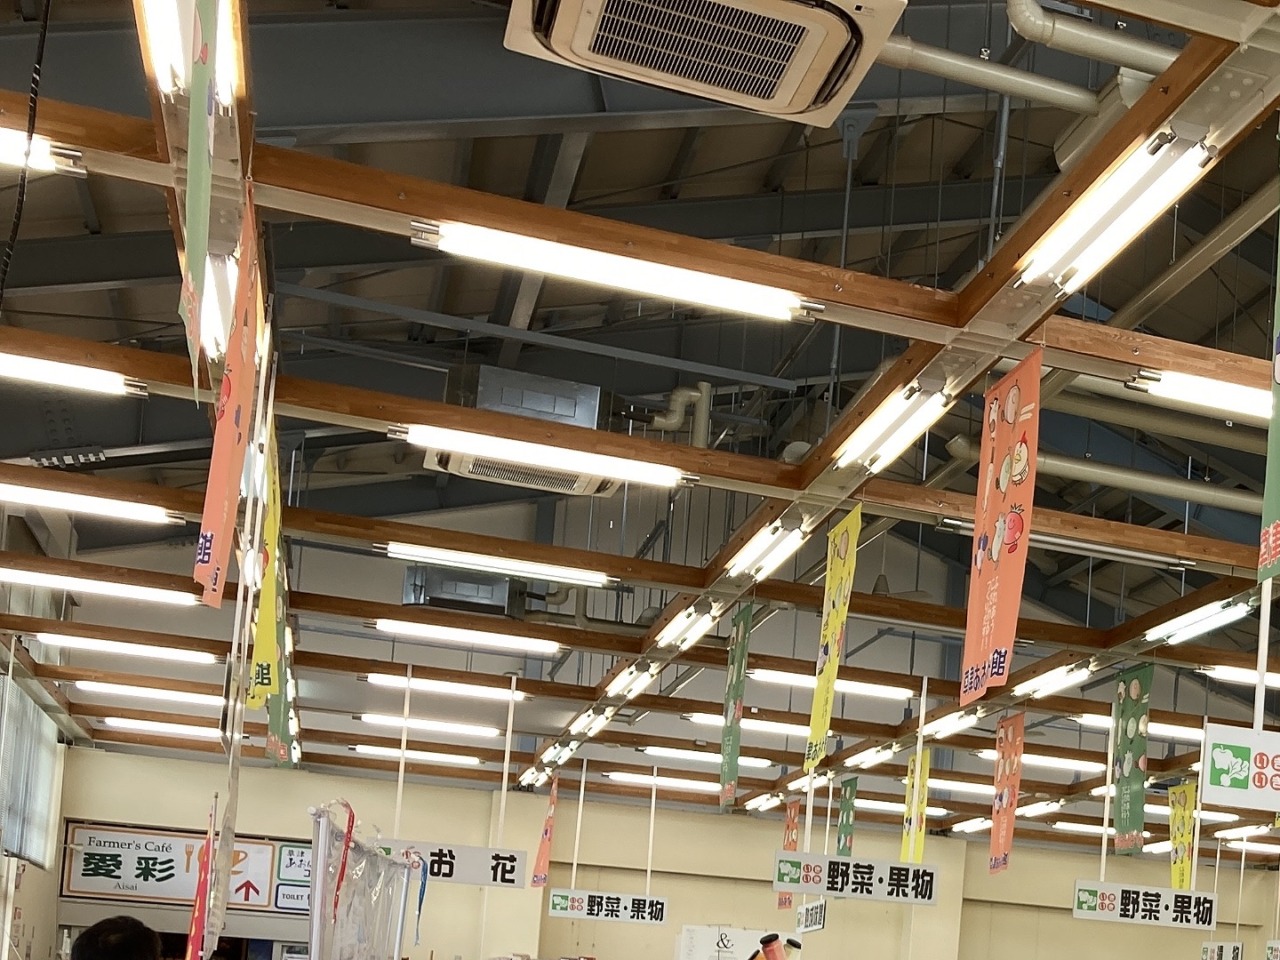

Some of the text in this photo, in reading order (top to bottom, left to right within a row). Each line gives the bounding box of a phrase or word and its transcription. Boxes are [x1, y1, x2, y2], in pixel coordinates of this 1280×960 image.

[87, 835, 140, 850] Farmer's
[144, 841, 173, 853] Café
[81, 852, 176, 883] 愛彩
[113, 881, 138, 891] Aisai
[826, 860, 935, 901] 野菜・果物
[282, 893, 305, 901] TOILET
[1119, 889, 1214, 926] 野菜・果物
[586, 894, 664, 922] 野菜・果物
